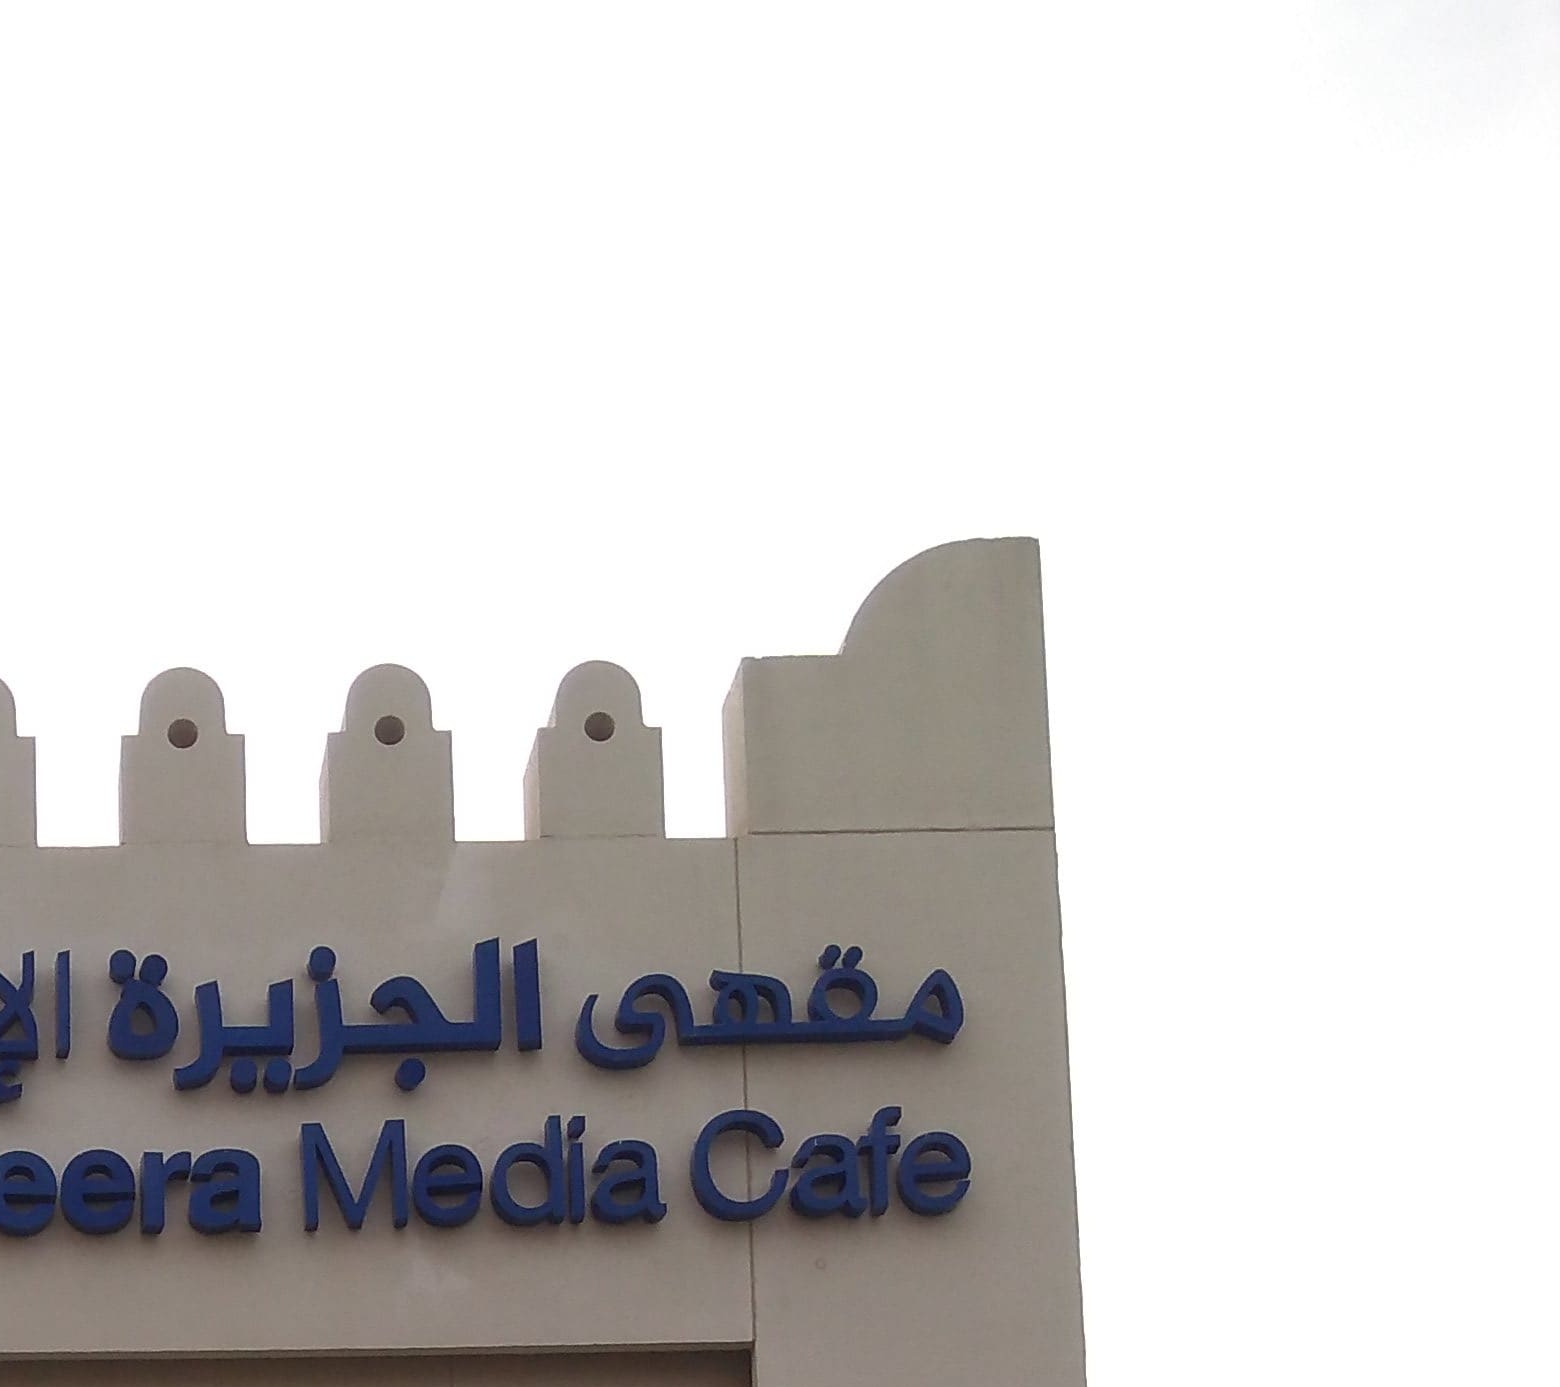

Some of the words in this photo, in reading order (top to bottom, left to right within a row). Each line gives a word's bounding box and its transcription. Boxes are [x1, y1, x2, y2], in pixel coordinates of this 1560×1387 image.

[104, 938, 544, 1092] الجزيرة
[576, 944, 966, 1068] مقهى
[300, 1119, 668, 1232] Media
[689, 1105, 972, 1220] Cafe
